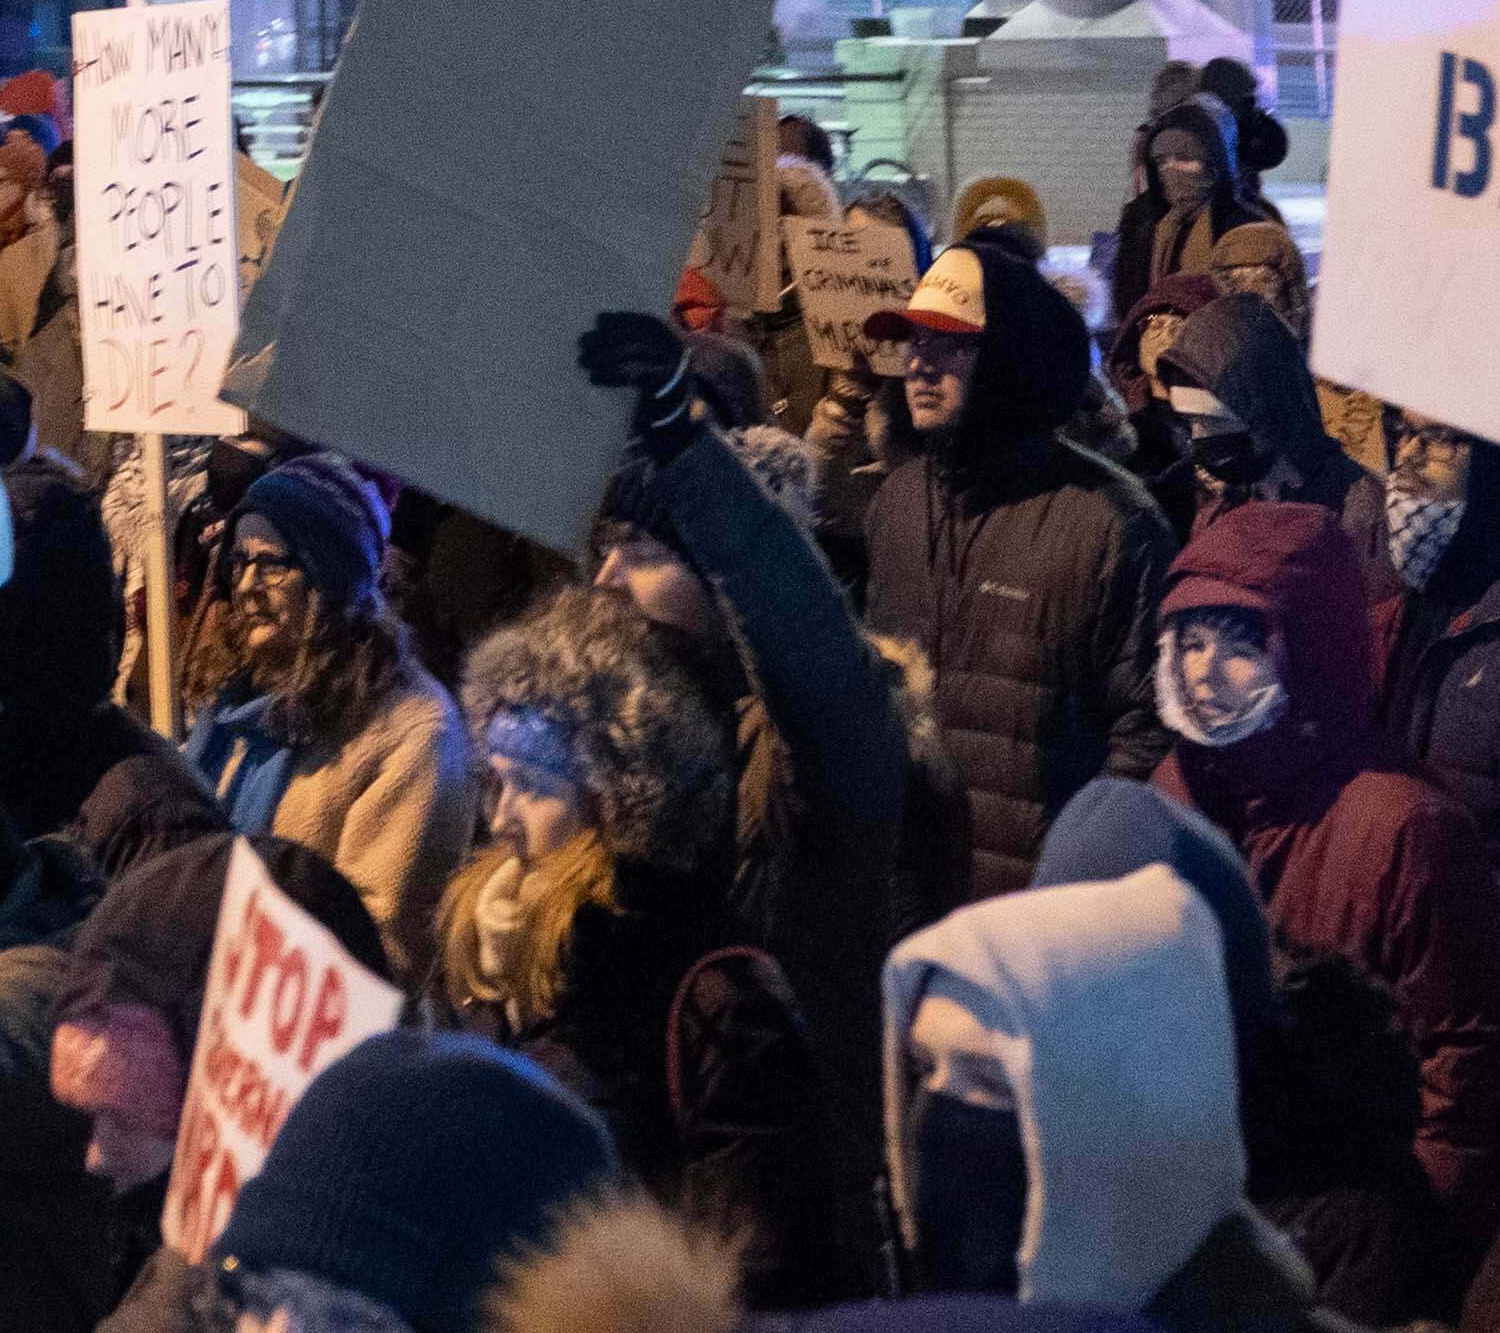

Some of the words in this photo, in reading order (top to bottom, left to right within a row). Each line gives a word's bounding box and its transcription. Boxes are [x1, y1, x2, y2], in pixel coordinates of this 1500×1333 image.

[146, 12, 228, 73] MANY
[110, 94, 206, 169] MORE
[101, 179, 223, 256] PEOPLE
[806, 229, 859, 253] ICE
[91, 269, 164, 329] HAVE
[173, 258, 226, 321] TO
[98, 329, 205, 419] DIE?
